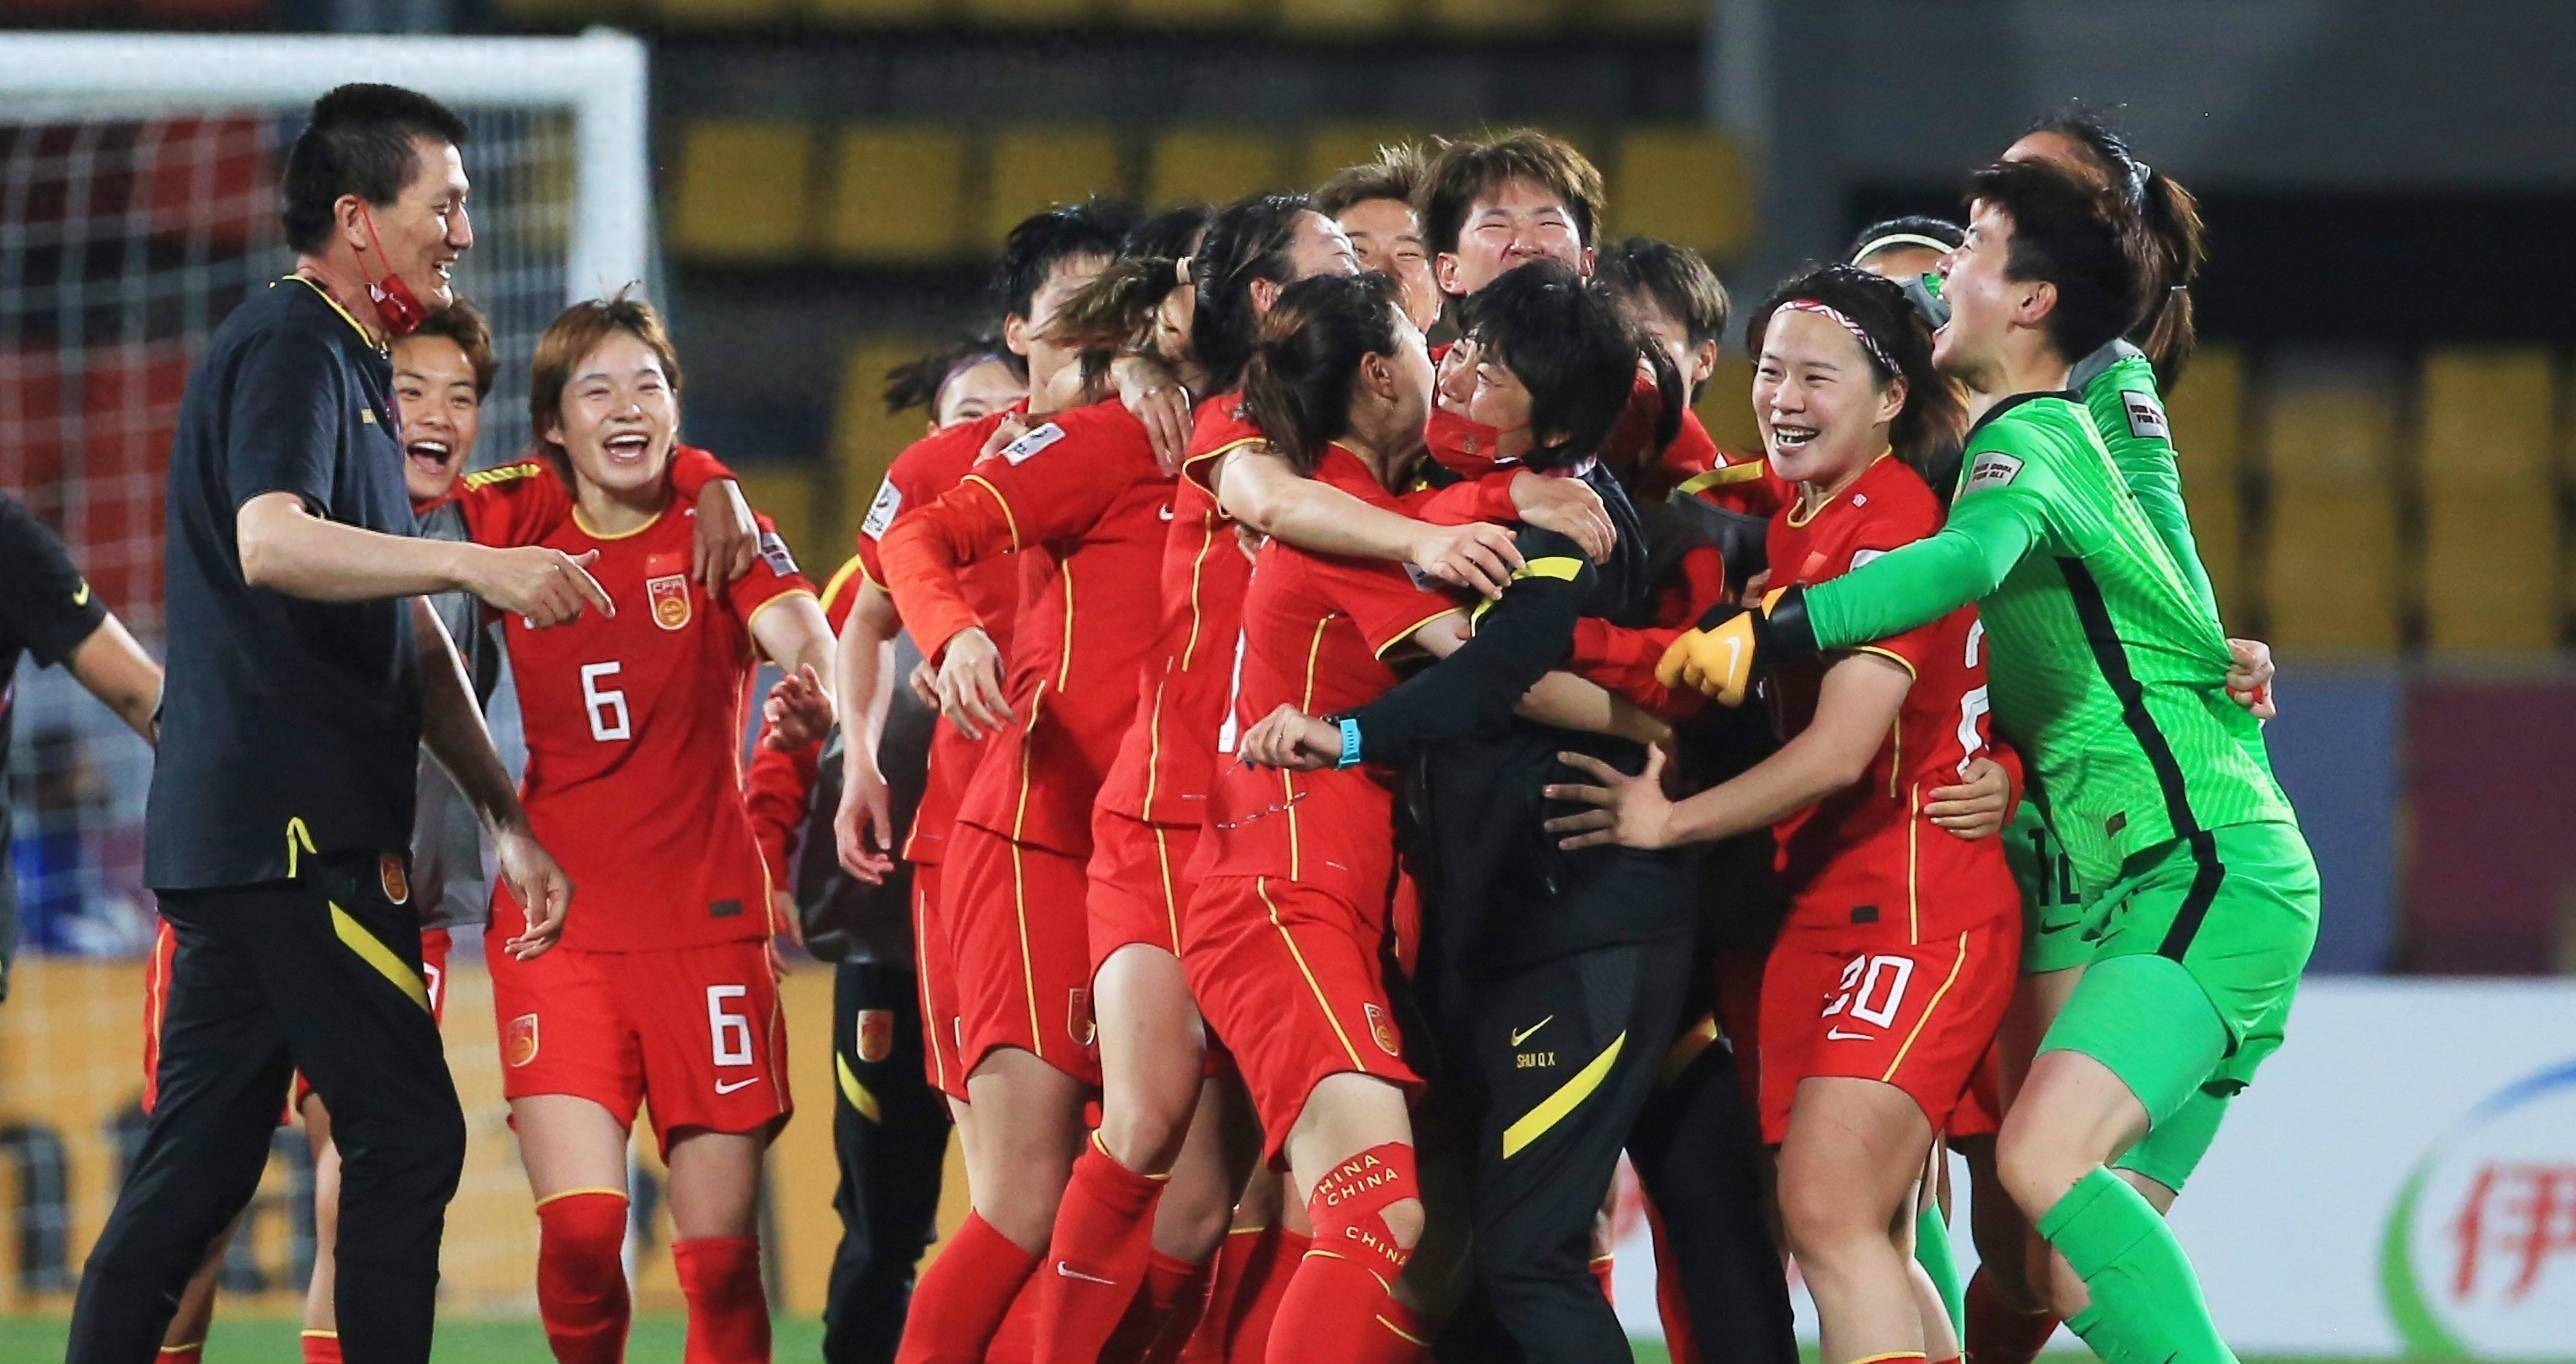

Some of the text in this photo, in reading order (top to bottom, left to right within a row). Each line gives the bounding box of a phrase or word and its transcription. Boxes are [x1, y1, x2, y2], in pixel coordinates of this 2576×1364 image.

[580, 661, 631, 741] 6
[707, 984, 753, 1066] 6
[1821, 954, 1915, 1029] 20
[1537, 1052, 1546, 1067] Q
[1547, 1051, 1556, 1066] X
[1327, 1167, 1399, 1206] CHINA
